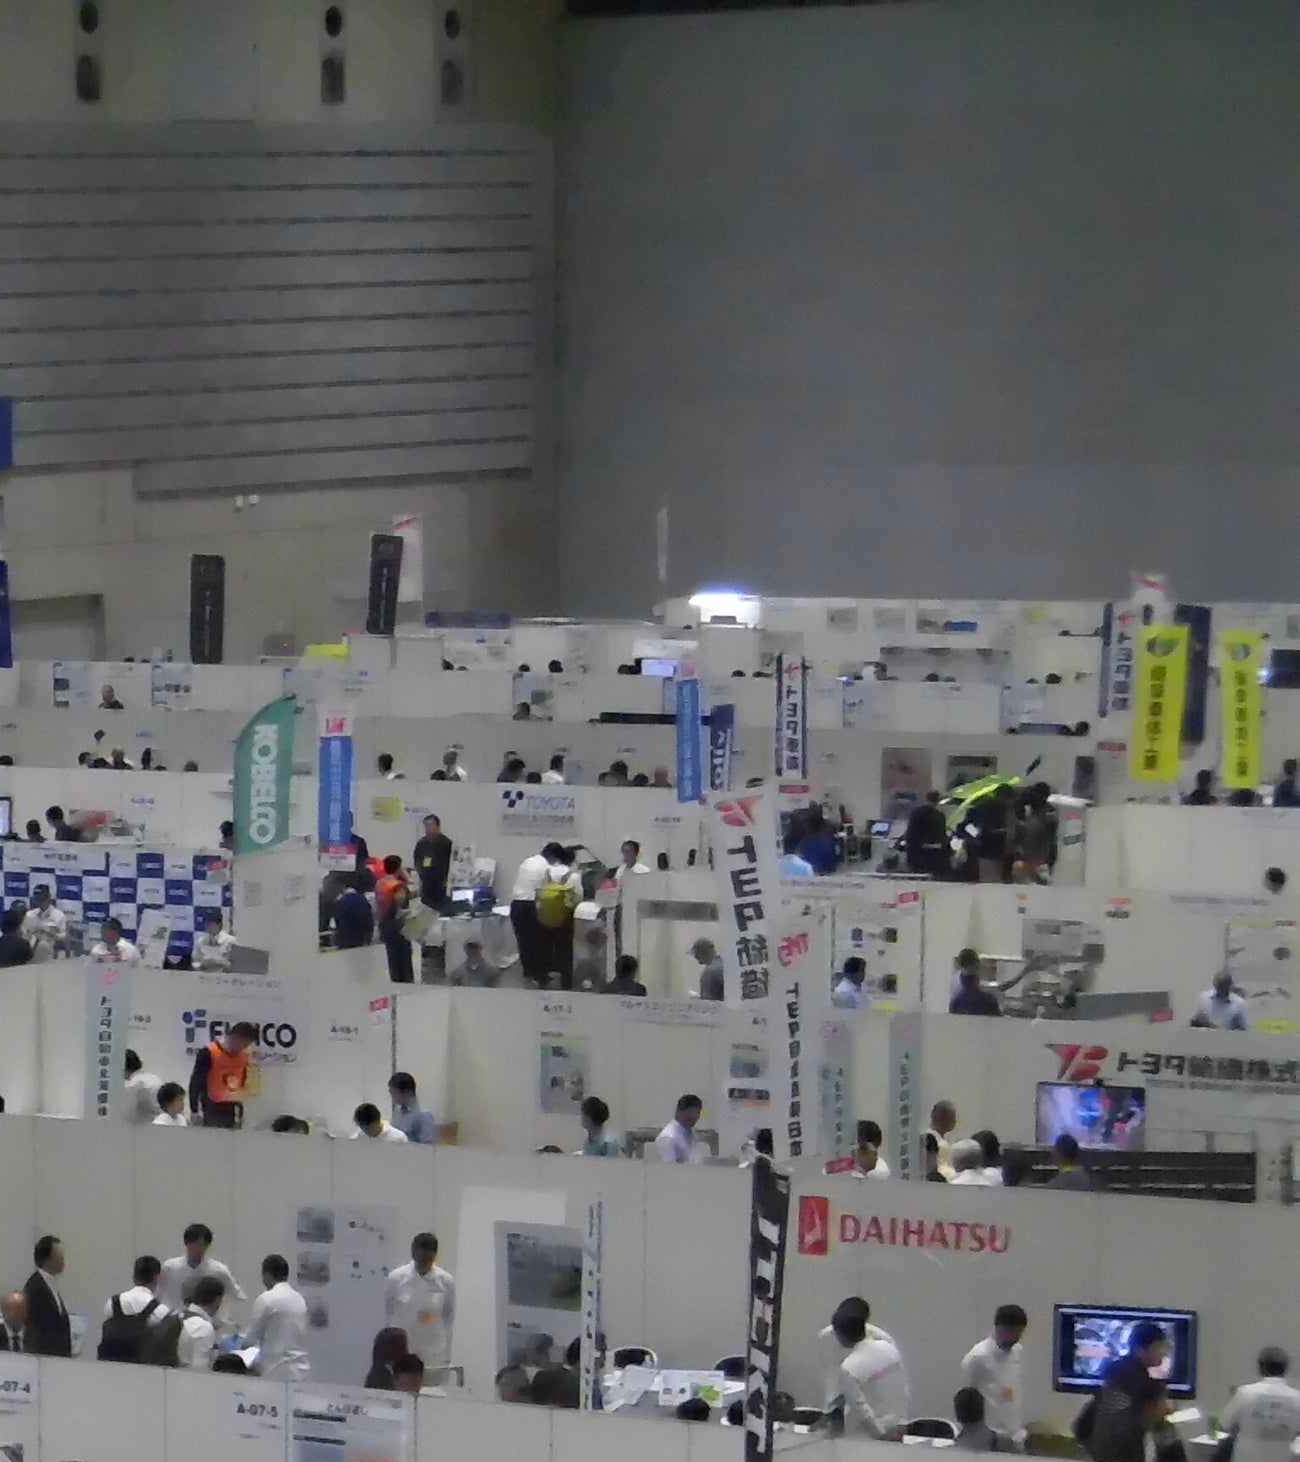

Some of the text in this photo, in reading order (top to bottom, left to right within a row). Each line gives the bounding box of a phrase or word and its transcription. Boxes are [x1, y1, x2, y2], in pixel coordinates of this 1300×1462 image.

[249, 725, 278, 844] KOBELCO
[839, 1214, 1012, 1254] DAIHATSU
[237, 1403, 278, 1418] A-07-5
